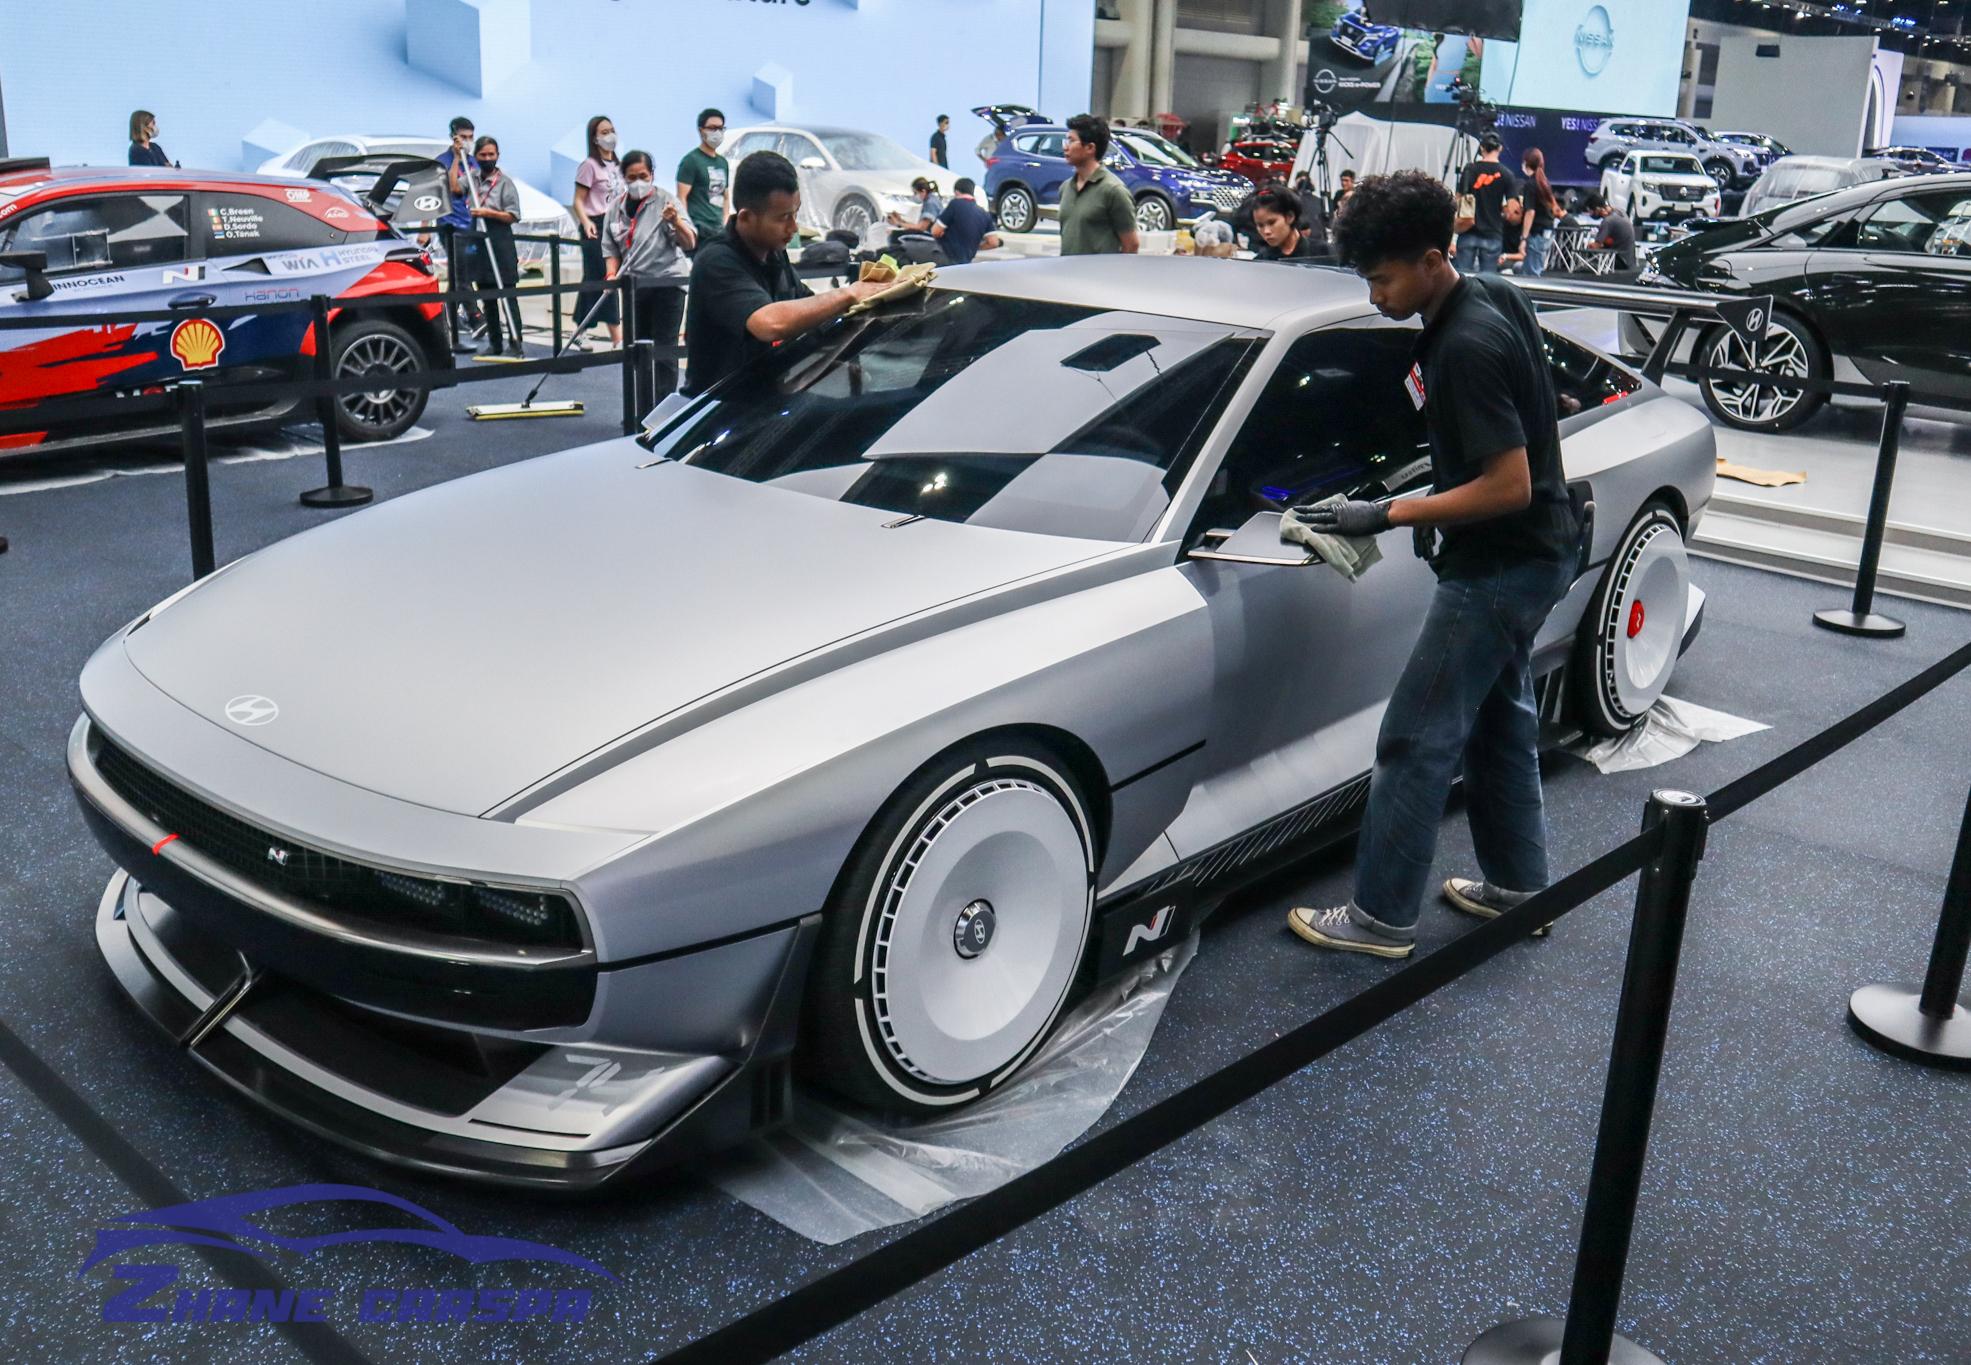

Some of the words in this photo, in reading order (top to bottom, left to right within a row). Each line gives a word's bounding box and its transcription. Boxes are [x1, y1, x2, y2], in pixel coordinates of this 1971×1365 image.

[1505, 114, 1536, 127] NISSAN
[1561, 117, 1579, 130] YES!
[53, 275, 125, 291] INNOCEAN
